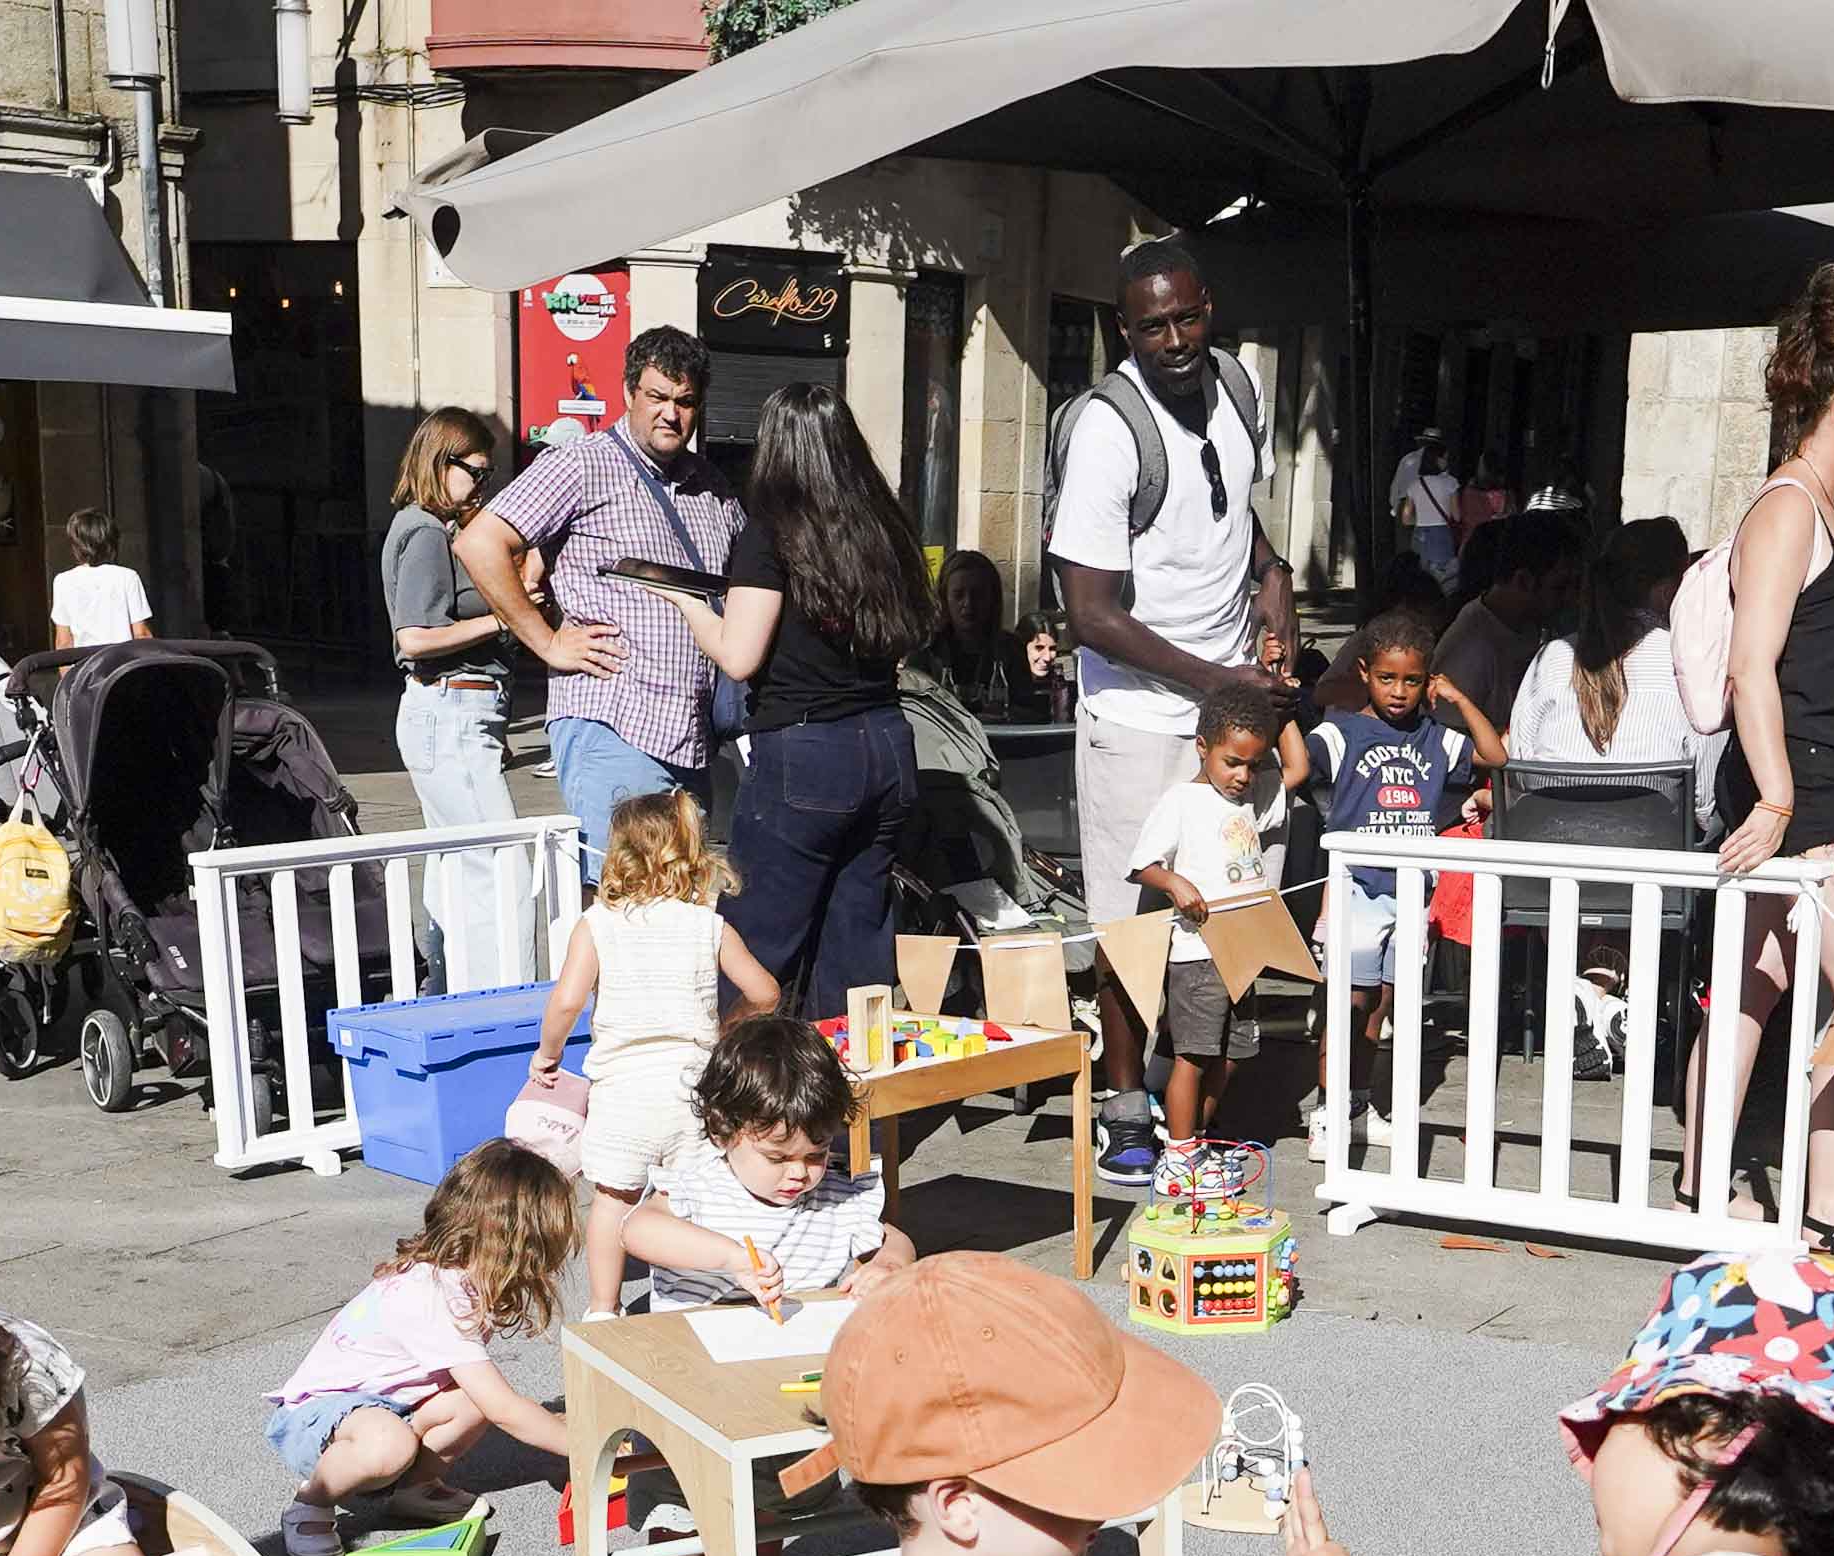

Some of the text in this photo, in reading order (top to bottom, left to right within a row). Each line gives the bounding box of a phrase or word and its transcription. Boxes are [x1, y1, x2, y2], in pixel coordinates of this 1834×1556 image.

[1381, 766, 1415, 785] NYC
[1385, 790, 1416, 804] 1984
[1369, 811, 1402, 825] EAST
